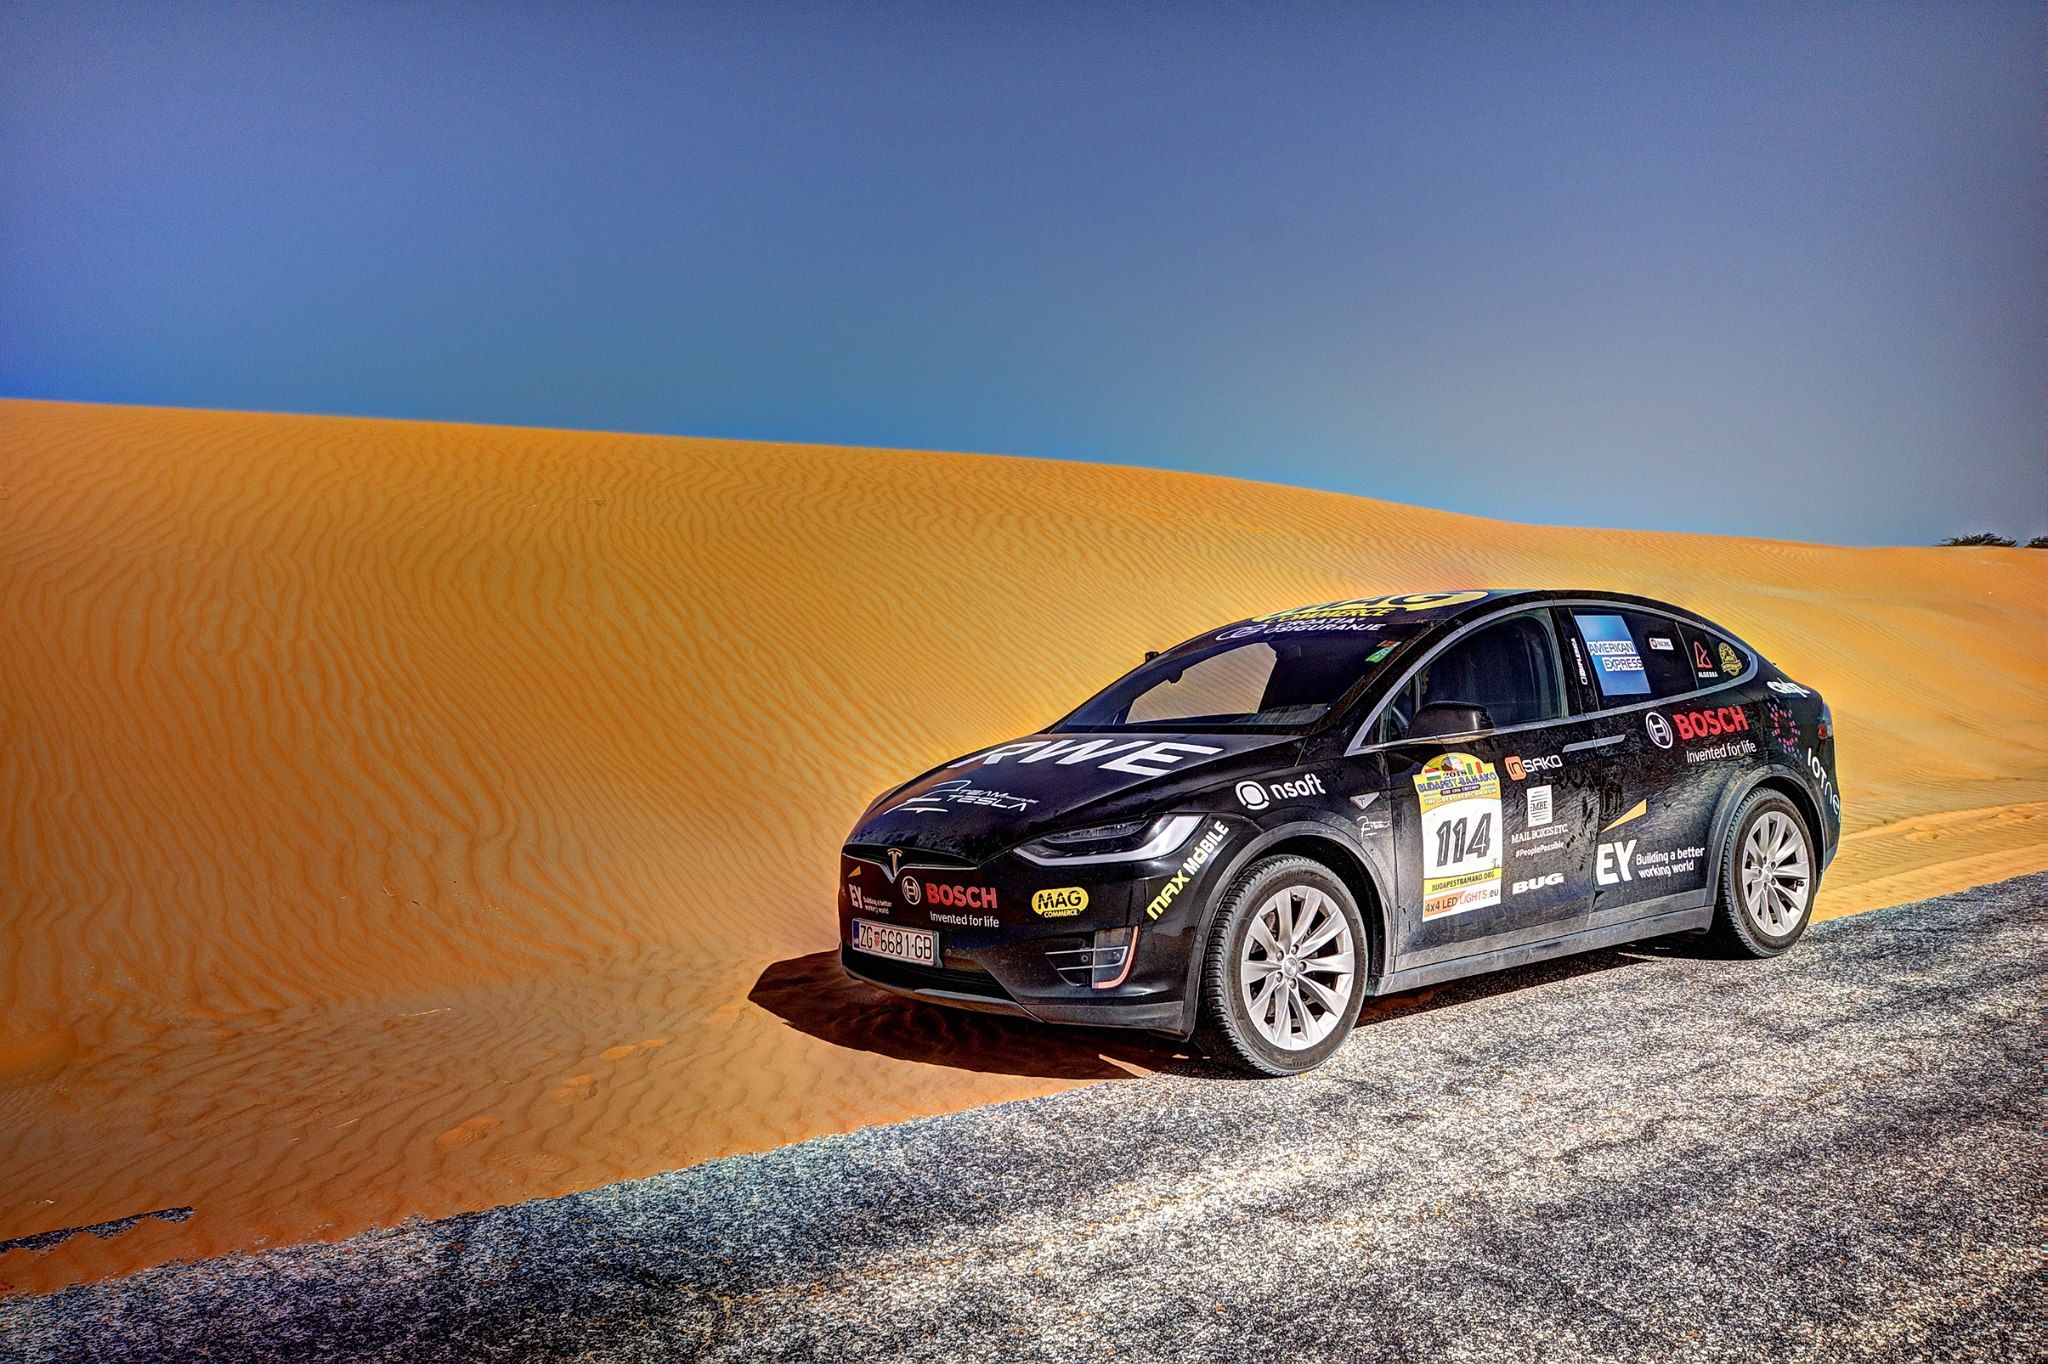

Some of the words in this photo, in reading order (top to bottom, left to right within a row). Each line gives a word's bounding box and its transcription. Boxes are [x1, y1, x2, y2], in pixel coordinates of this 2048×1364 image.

[1264, 624, 1387, 634] OSIGURANJE
[1588, 642, 1634, 655] AMERICAN
[1604, 658, 1643, 670] EXPRESS
[1673, 705, 1750, 740] BOSCH
[947, 739, 1224, 777] RWE
[1686, 745, 1726, 764] Invented
[1727, 743, 1742, 757] for
[1742, 740, 1757, 754] life
[959, 789, 1010, 799] TEAM
[1269, 773, 1327, 800] nsoft
[947, 795, 1027, 812] TESLA
[1532, 800, 1548, 812] MBE
[1436, 812, 1492, 868] 114
[1511, 831, 1531, 844] MAIL
[1531, 826, 1554, 840] BOXES
[1554, 824, 1569, 835] ETC.
[1596, 839, 1638, 886] EY
[1636, 850, 1669, 866] Building
[1669, 851, 1676, 861] a
[1677, 846, 1706, 860] better
[1638, 865, 1672, 879] working
[1672, 860, 1695, 874] world
[1512, 872, 1565, 895] BUG
[848, 883, 863, 909] EY
[926, 883, 998, 909] BOSCH
[1037, 890, 1082, 910] MAG
[1146, 870, 1191, 921] MAX
[1044, 908, 1078, 918] COMMERCE
[1425, 902, 1441, 913] 4x4
[930, 910, 967, 925] Invented
[969, 913, 983, 926] for
[984, 915, 1000, 928] life
[860, 924, 873, 949] ZG
